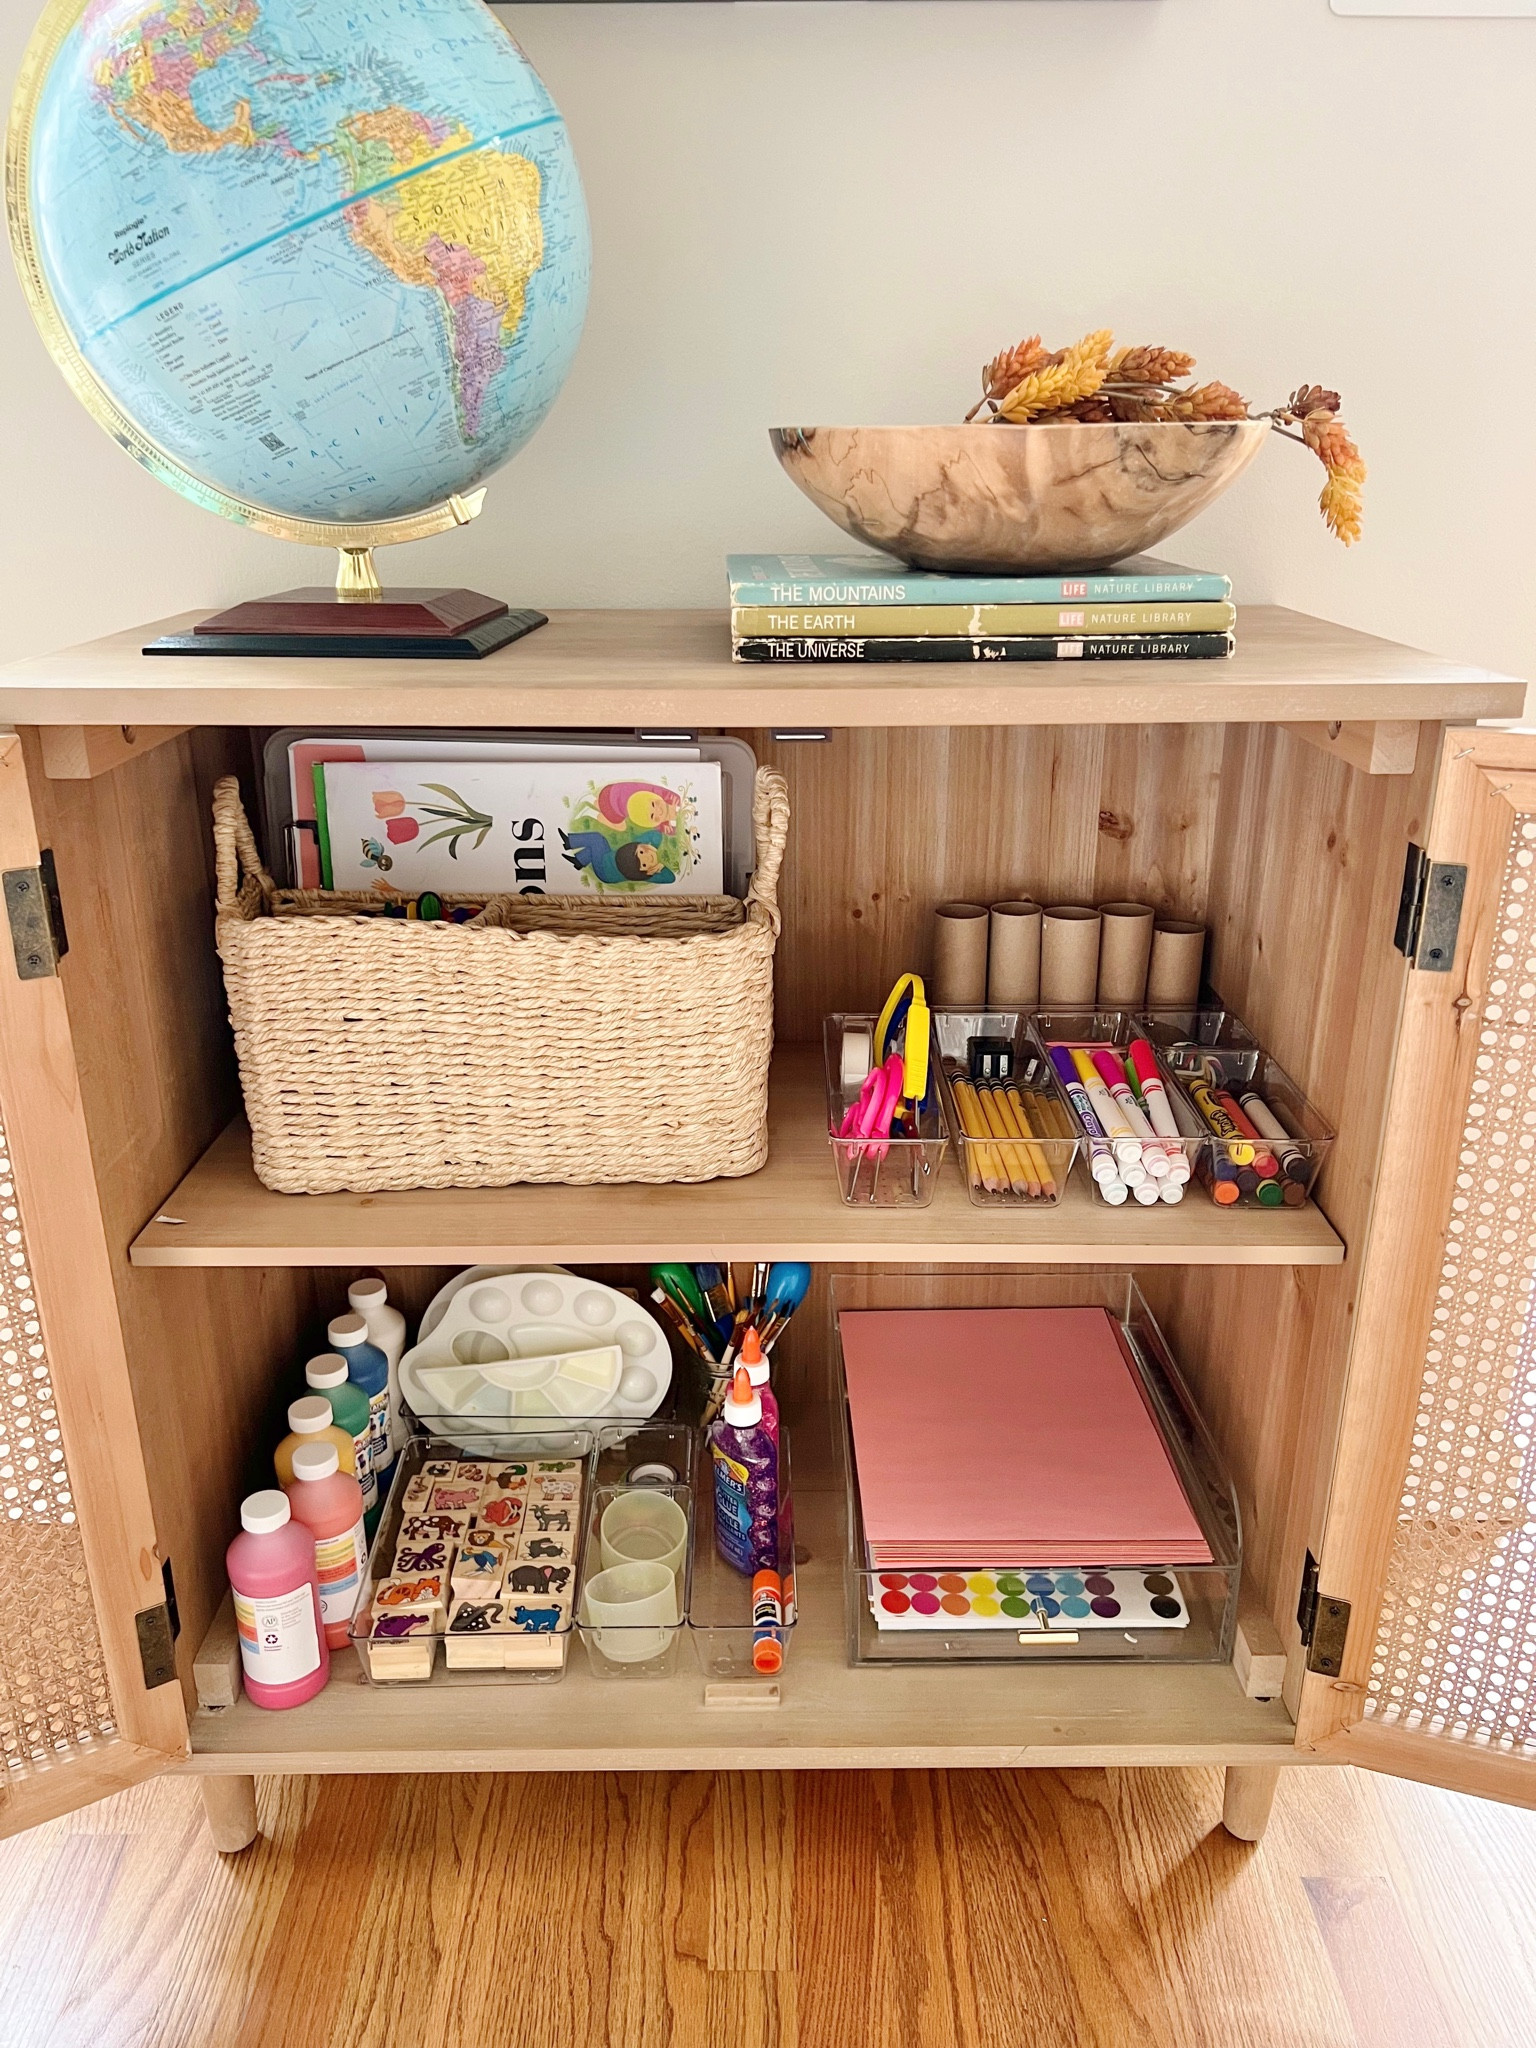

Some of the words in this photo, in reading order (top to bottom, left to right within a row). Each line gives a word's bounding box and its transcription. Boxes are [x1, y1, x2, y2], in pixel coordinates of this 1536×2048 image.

[413, 178, 506, 224] SOUTH
[108, 241, 135, 265] World
[135, 226, 170, 251] Nation
[156, 302, 184, 322] LEGEND
[771, 586, 802, 601] THE
[809, 585, 906, 601] MOUNTAINS
[1063, 583, 1086, 596] LIFE
[1094, 583, 1139, 595] NATURE
[1144, 582, 1194, 593] LIBRARY
[768, 615, 799, 630] THE
[803, 615, 855, 630] EARTH
[1059, 613, 1083, 626] LIFE
[1091, 613, 1136, 624] NATURE
[1142, 612, 1192, 623] LIBRARY
[767, 642, 794, 658] THE
[797, 642, 865, 658] UNIVERSE
[1059, 644, 1083, 656] LIFE
[1090, 644, 1135, 655] NATURE
[1140, 643, 1190, 655] LIBRARY
